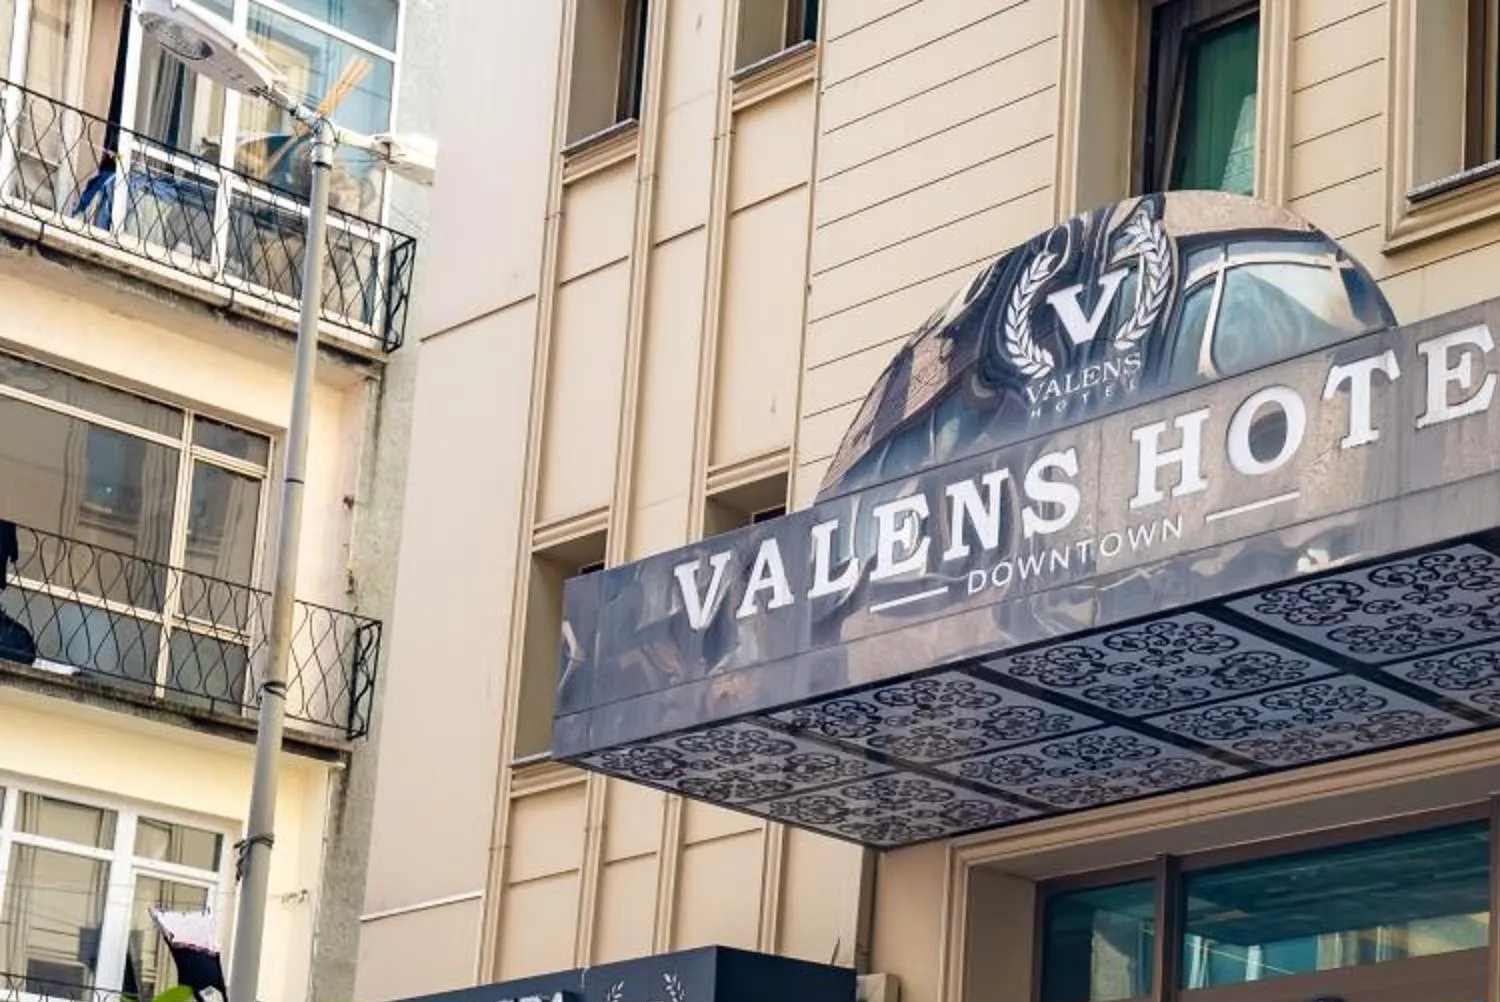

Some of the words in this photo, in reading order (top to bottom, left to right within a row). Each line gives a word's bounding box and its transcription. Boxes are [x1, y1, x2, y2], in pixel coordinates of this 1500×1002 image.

[1047, 268, 1129, 344] V
[1026, 352, 1141, 403] VALENS
[1031, 378, 1136, 418] HOTEL
[673, 445, 1083, 631] VALENS
[967, 515, 1186, 595] DOWNTOWN
